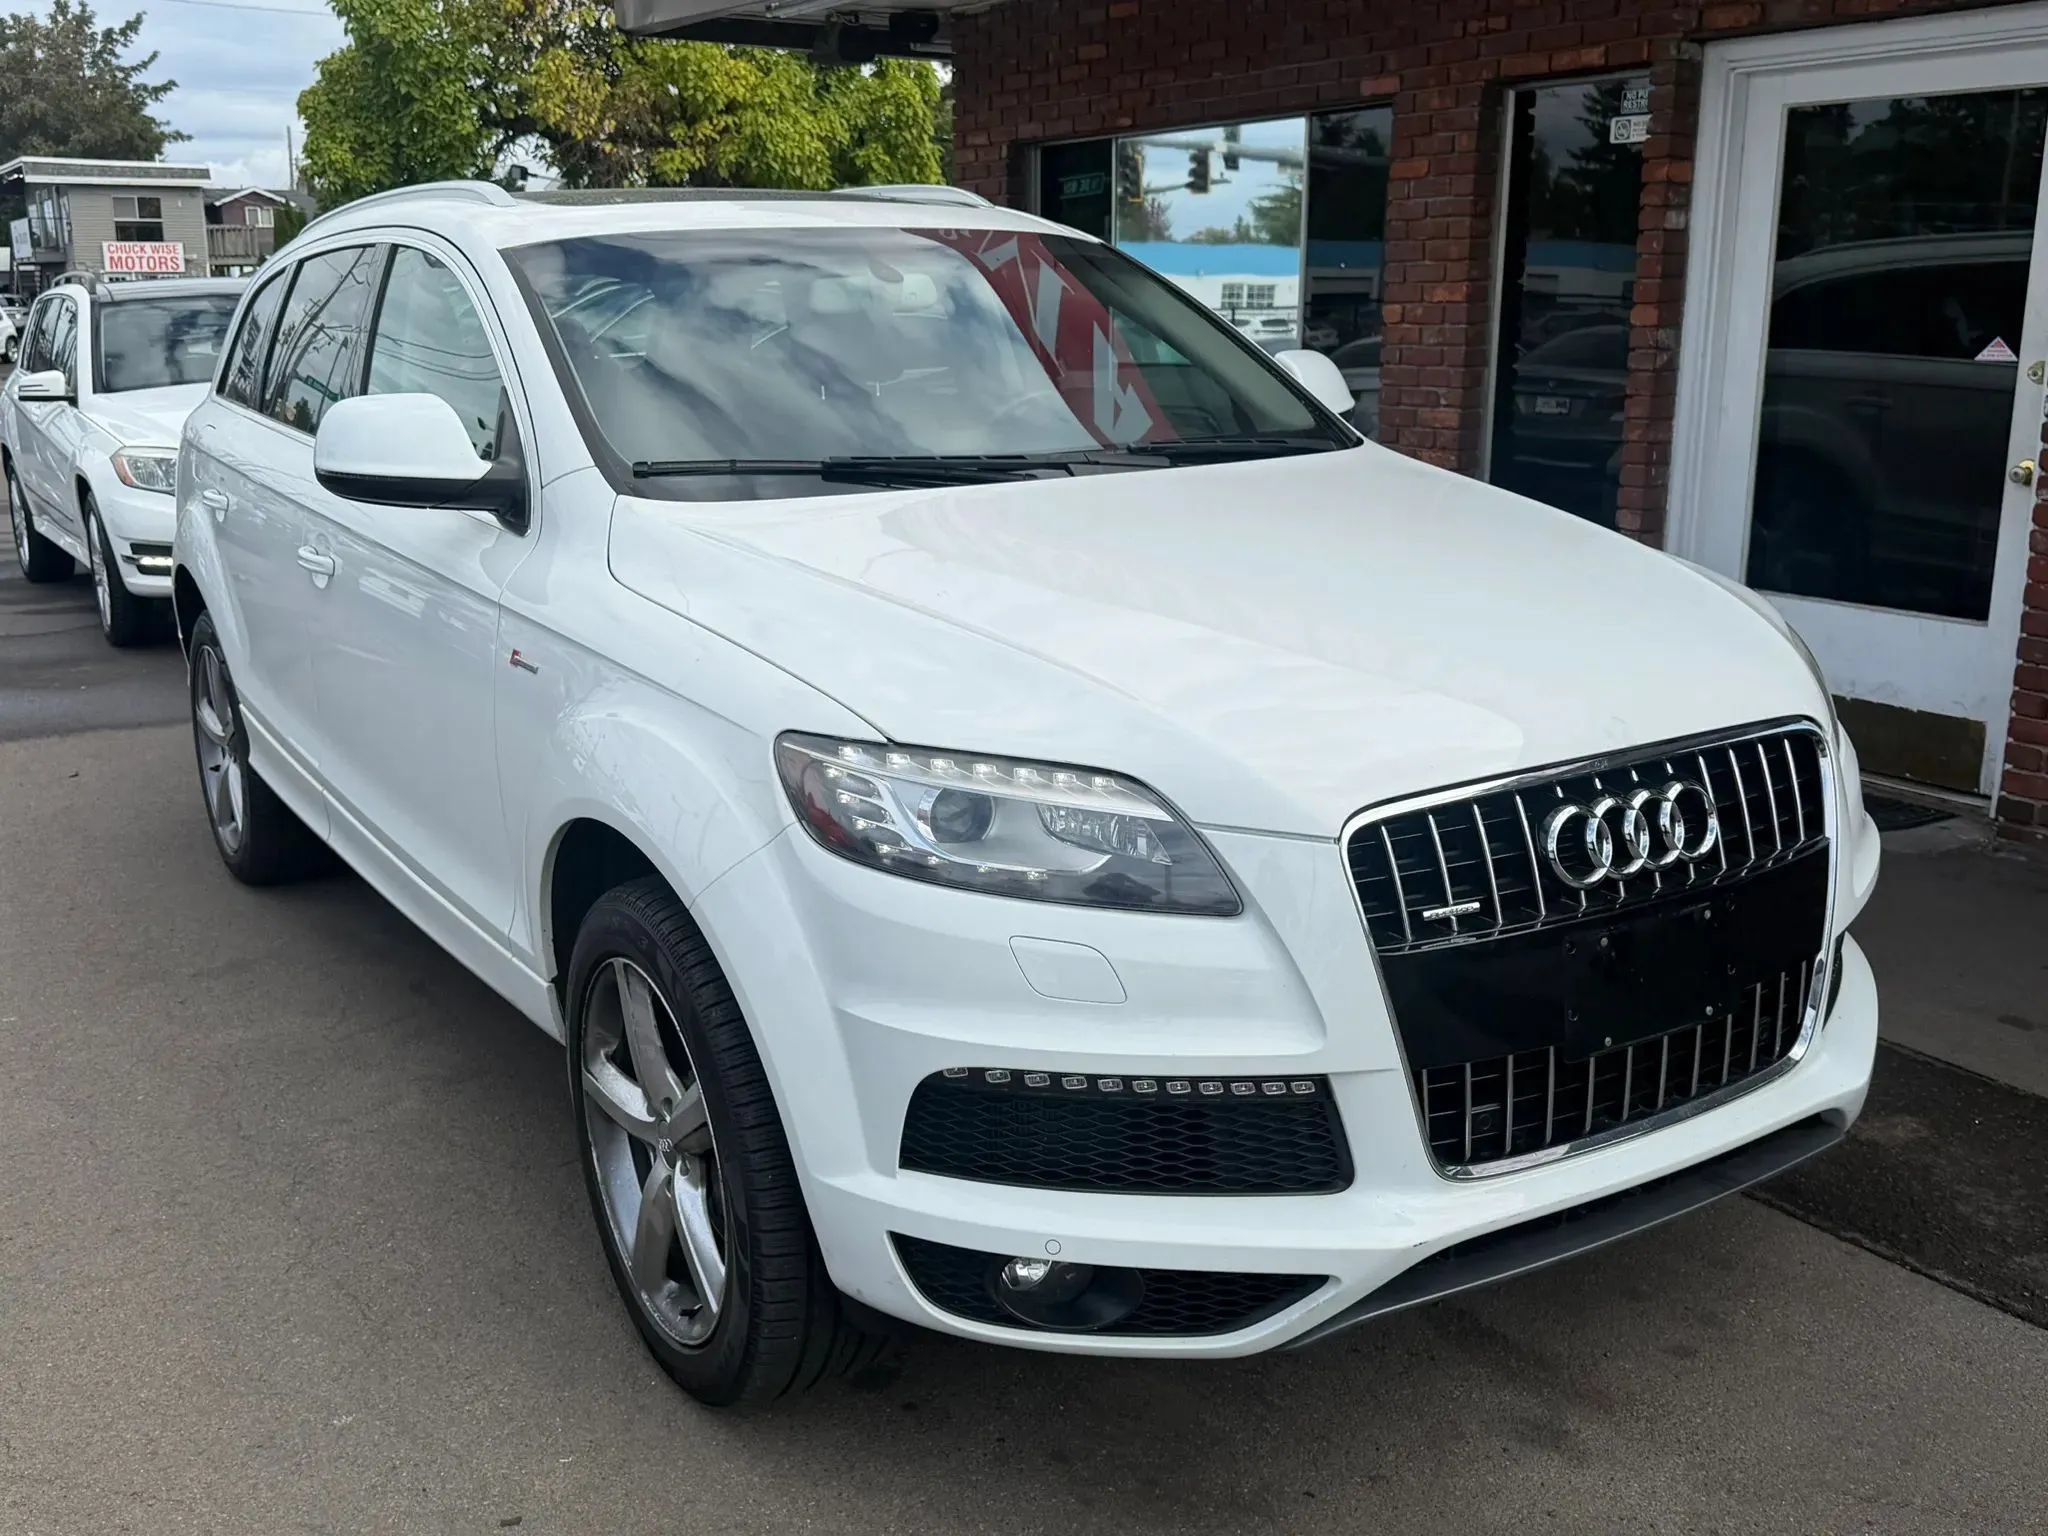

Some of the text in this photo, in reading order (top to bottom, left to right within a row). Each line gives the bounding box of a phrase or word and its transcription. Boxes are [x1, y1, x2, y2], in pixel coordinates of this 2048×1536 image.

[107, 243, 179, 254] CHUCK WISE
[109, 256, 180, 270] MOTORS
